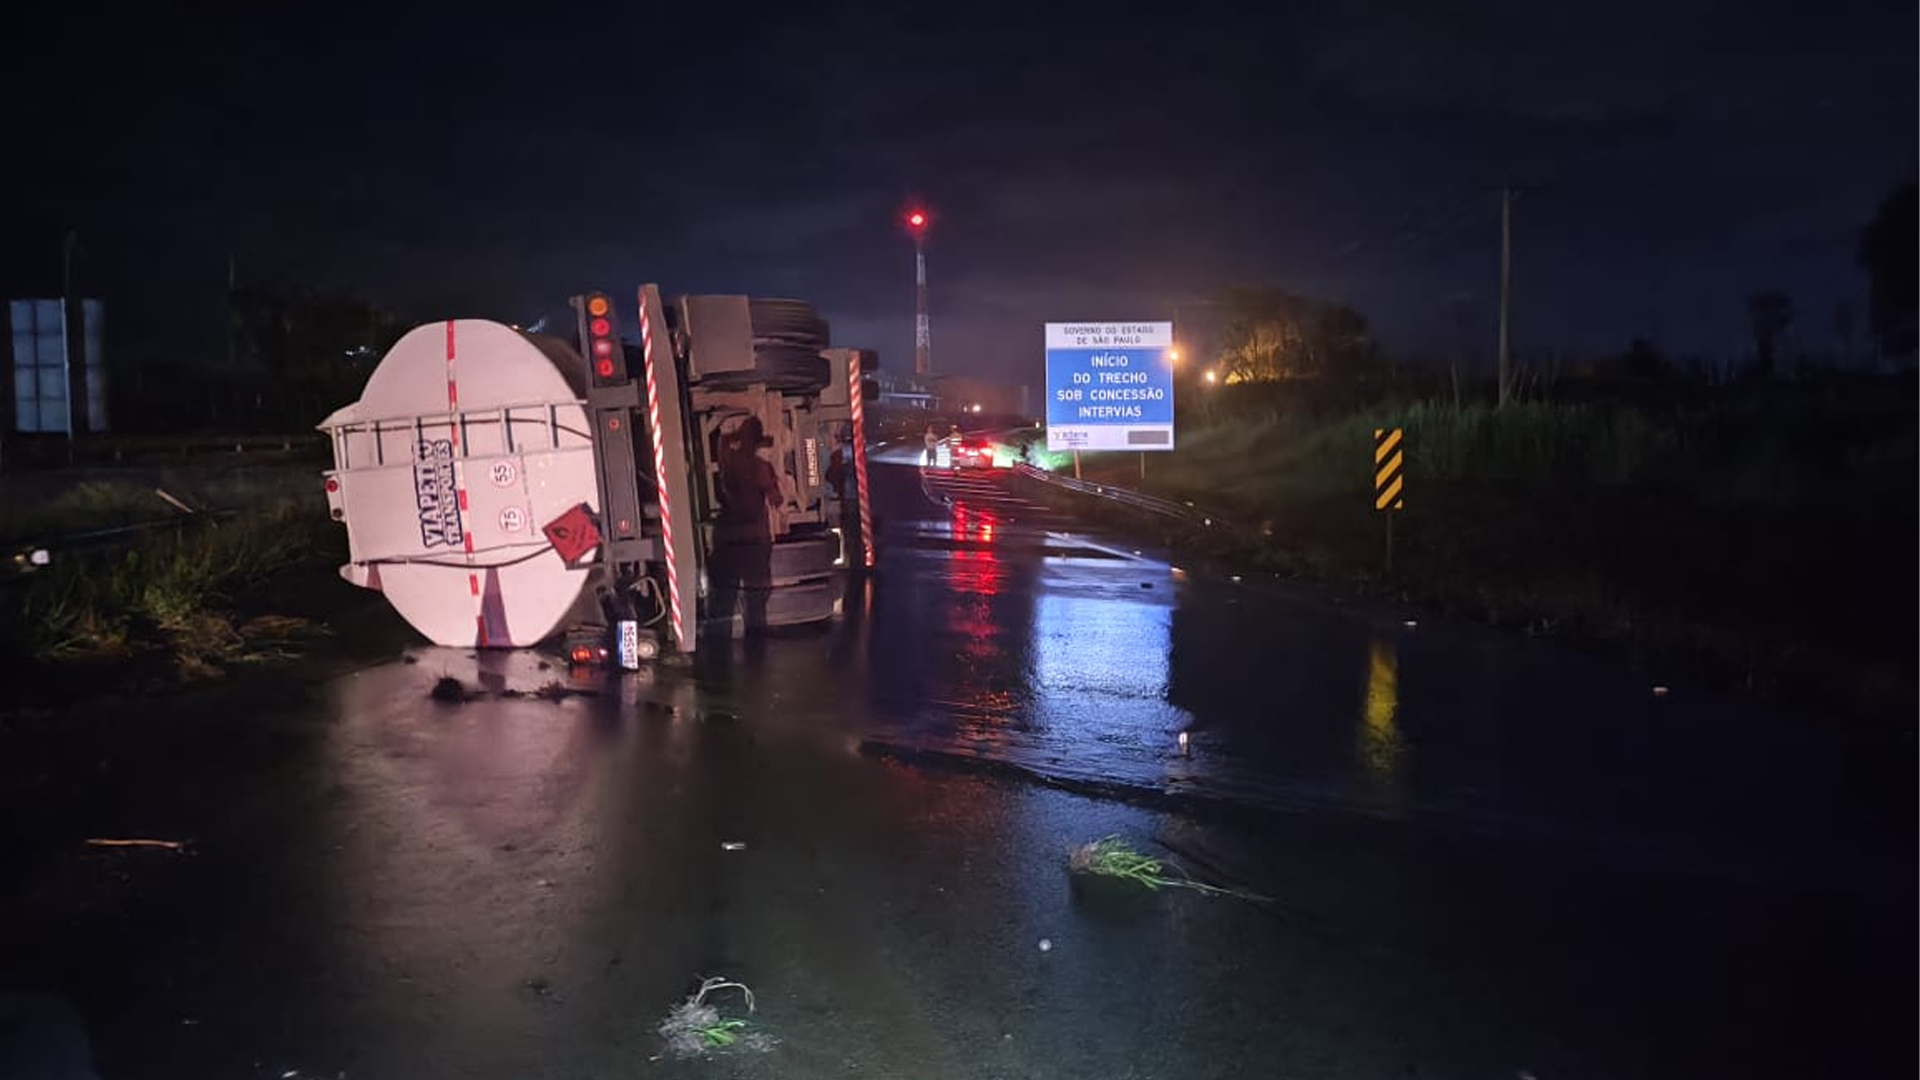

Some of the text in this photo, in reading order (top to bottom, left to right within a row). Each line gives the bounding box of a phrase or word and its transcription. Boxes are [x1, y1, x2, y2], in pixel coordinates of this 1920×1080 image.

[1064, 325, 1154, 335] GOVERNO DO ESTADO
[1077, 335, 1141, 345] DE SÃO PAULO
[1091, 352, 1128, 367] INÍCIO
[1073, 372, 1147, 384] DO TRECHO
[1057, 387, 1164, 401] SOB CONCESSÃO
[1079, 405, 1141, 418] INTERVIAS
[494, 464, 509, 482] 55
[435, 440, 462, 544] TRANSPORTES
[504, 511, 518, 530] 75
